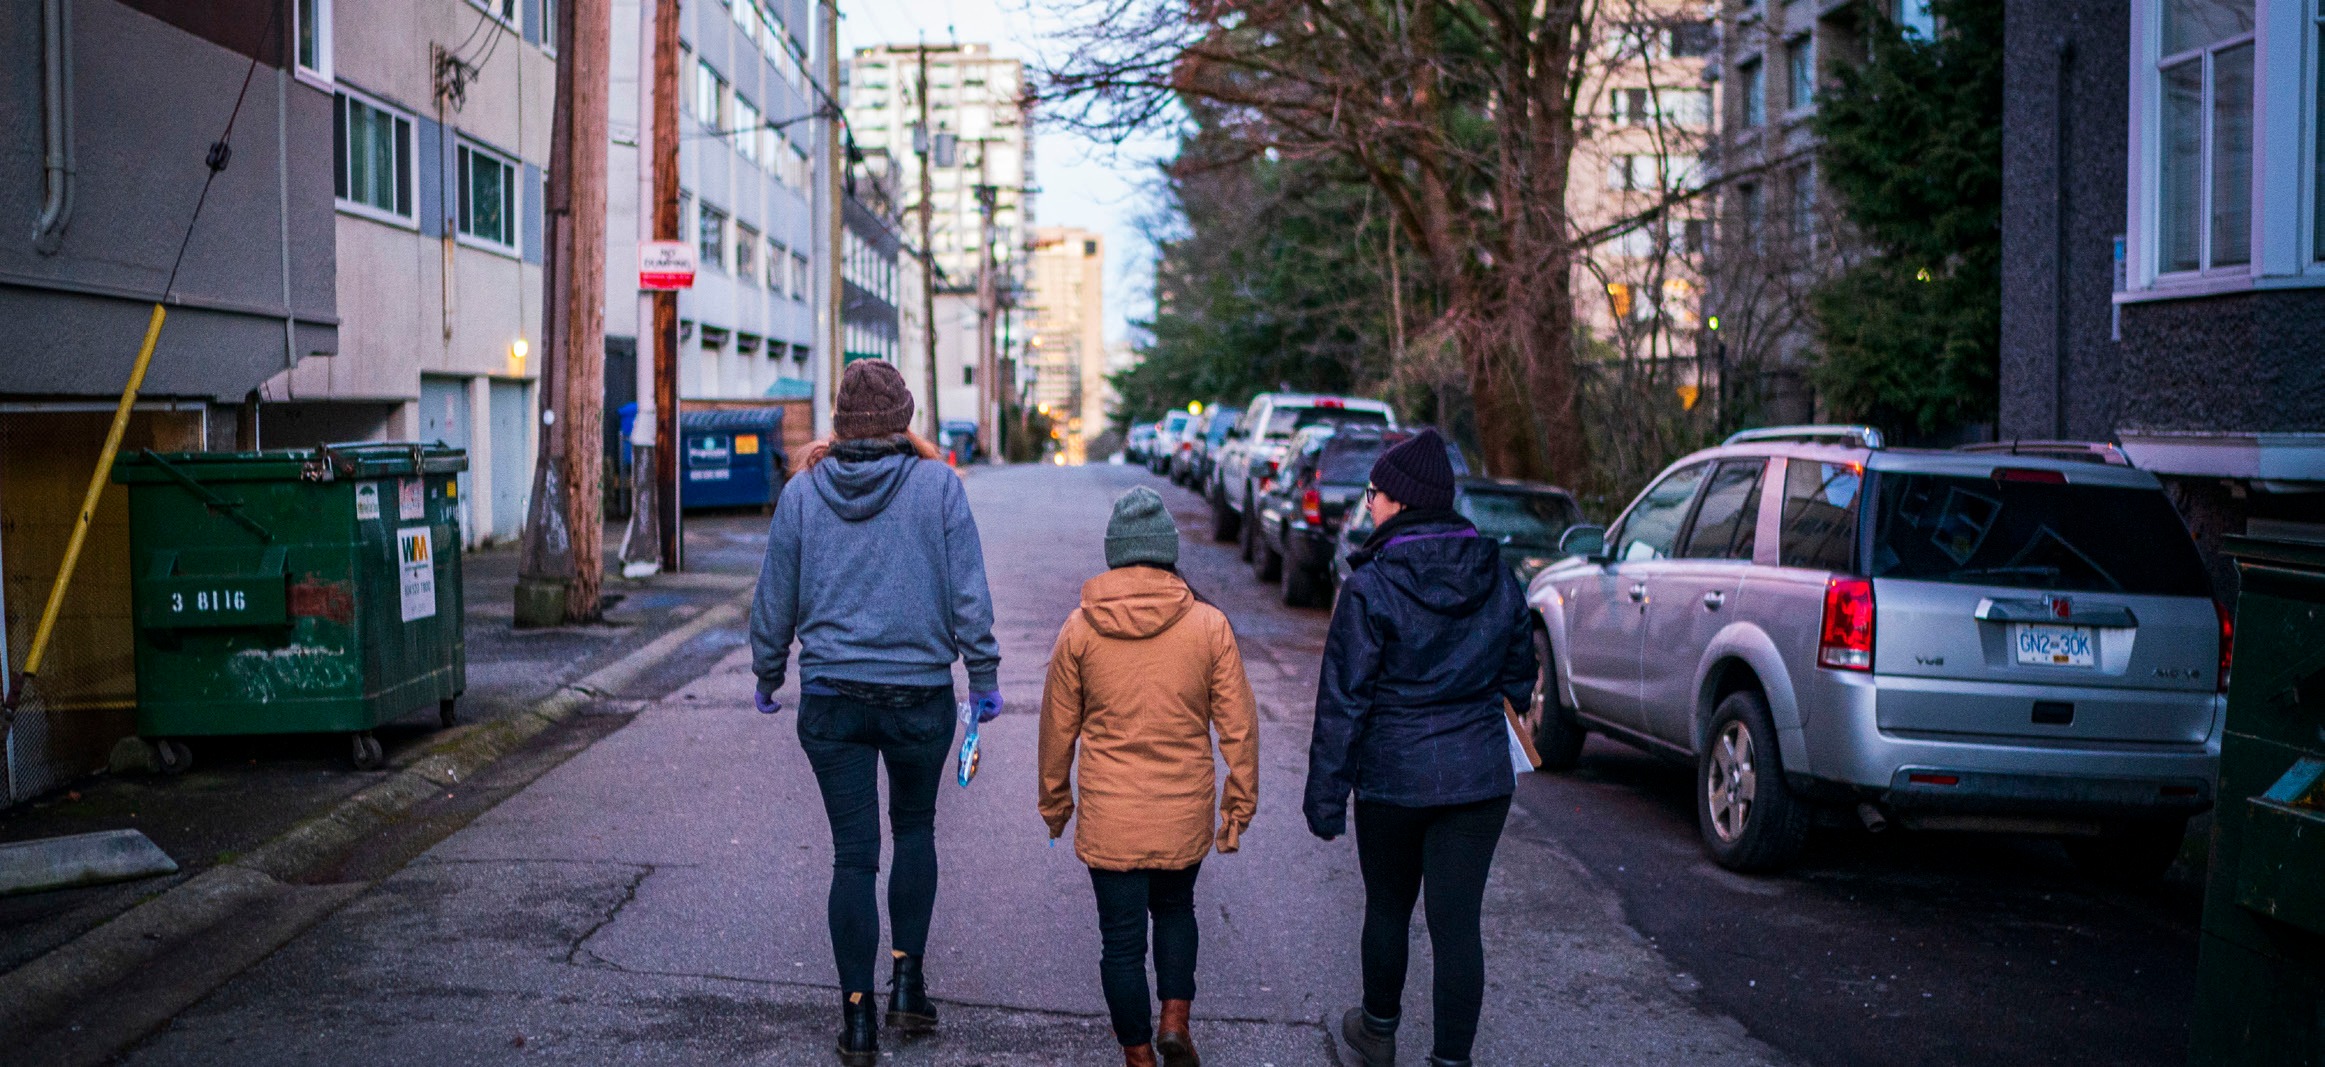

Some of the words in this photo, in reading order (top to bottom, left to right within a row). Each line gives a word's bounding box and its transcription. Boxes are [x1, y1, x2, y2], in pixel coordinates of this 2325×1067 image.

[401, 534, 429, 564] WM
[172, 592, 184, 612] 3
[197, 589, 246, 612] 8116
